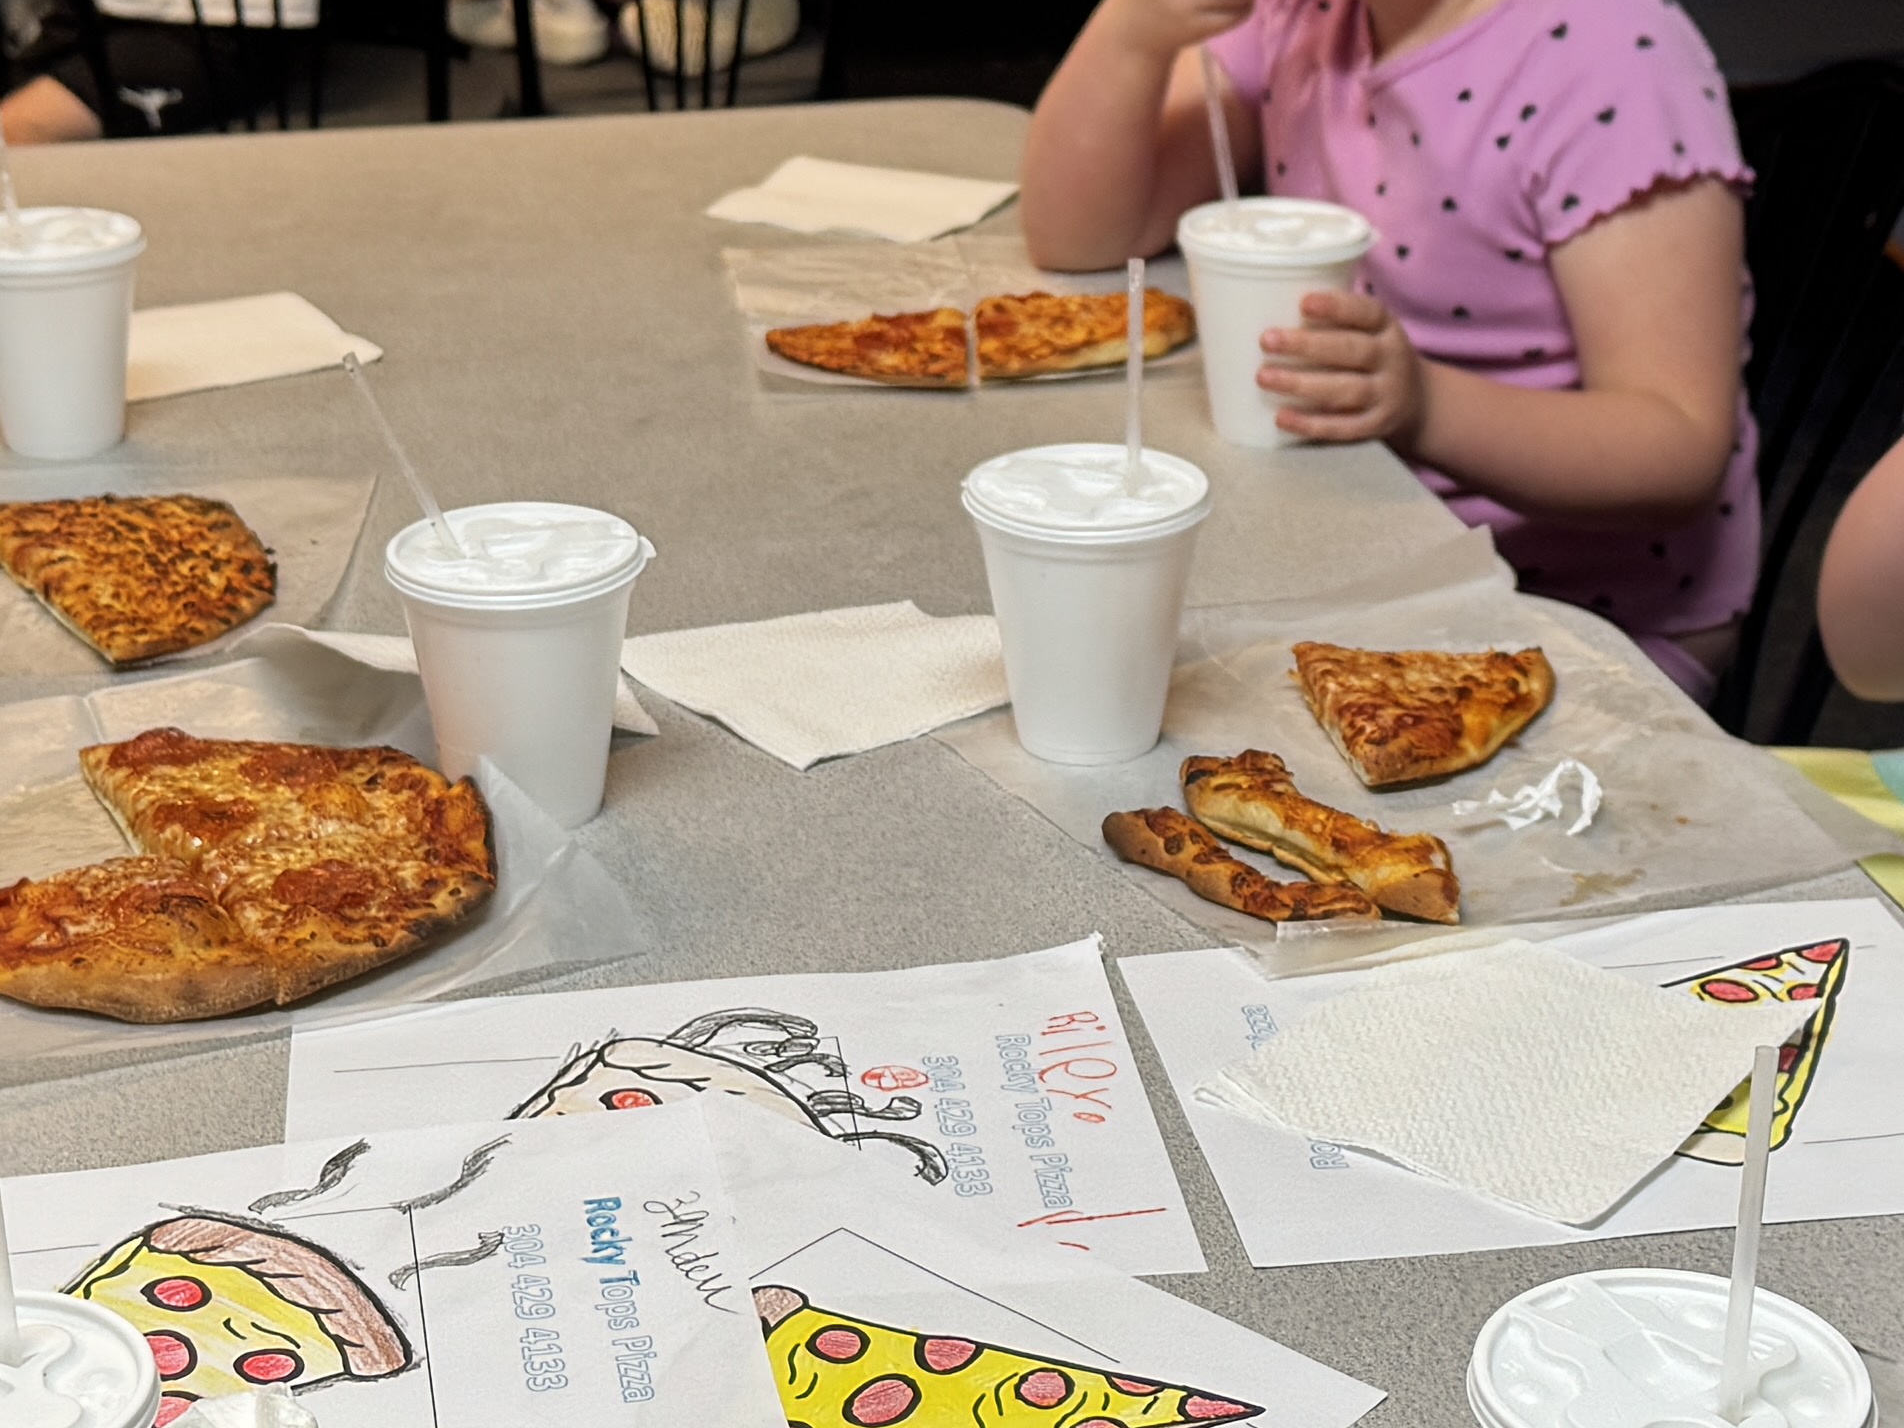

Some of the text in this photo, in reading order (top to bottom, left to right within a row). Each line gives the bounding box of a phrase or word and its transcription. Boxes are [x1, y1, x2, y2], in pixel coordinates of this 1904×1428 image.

[1241, 1003, 1280, 1052] izza
[922, 1054, 993, 1198] 304 429 4133
[996, 1033, 1074, 1210] Rocky Tops Pizza
[501, 1223, 569, 1393] 304 429 4133
[578, 1196, 658, 1404] Rocky Tops Pizza
